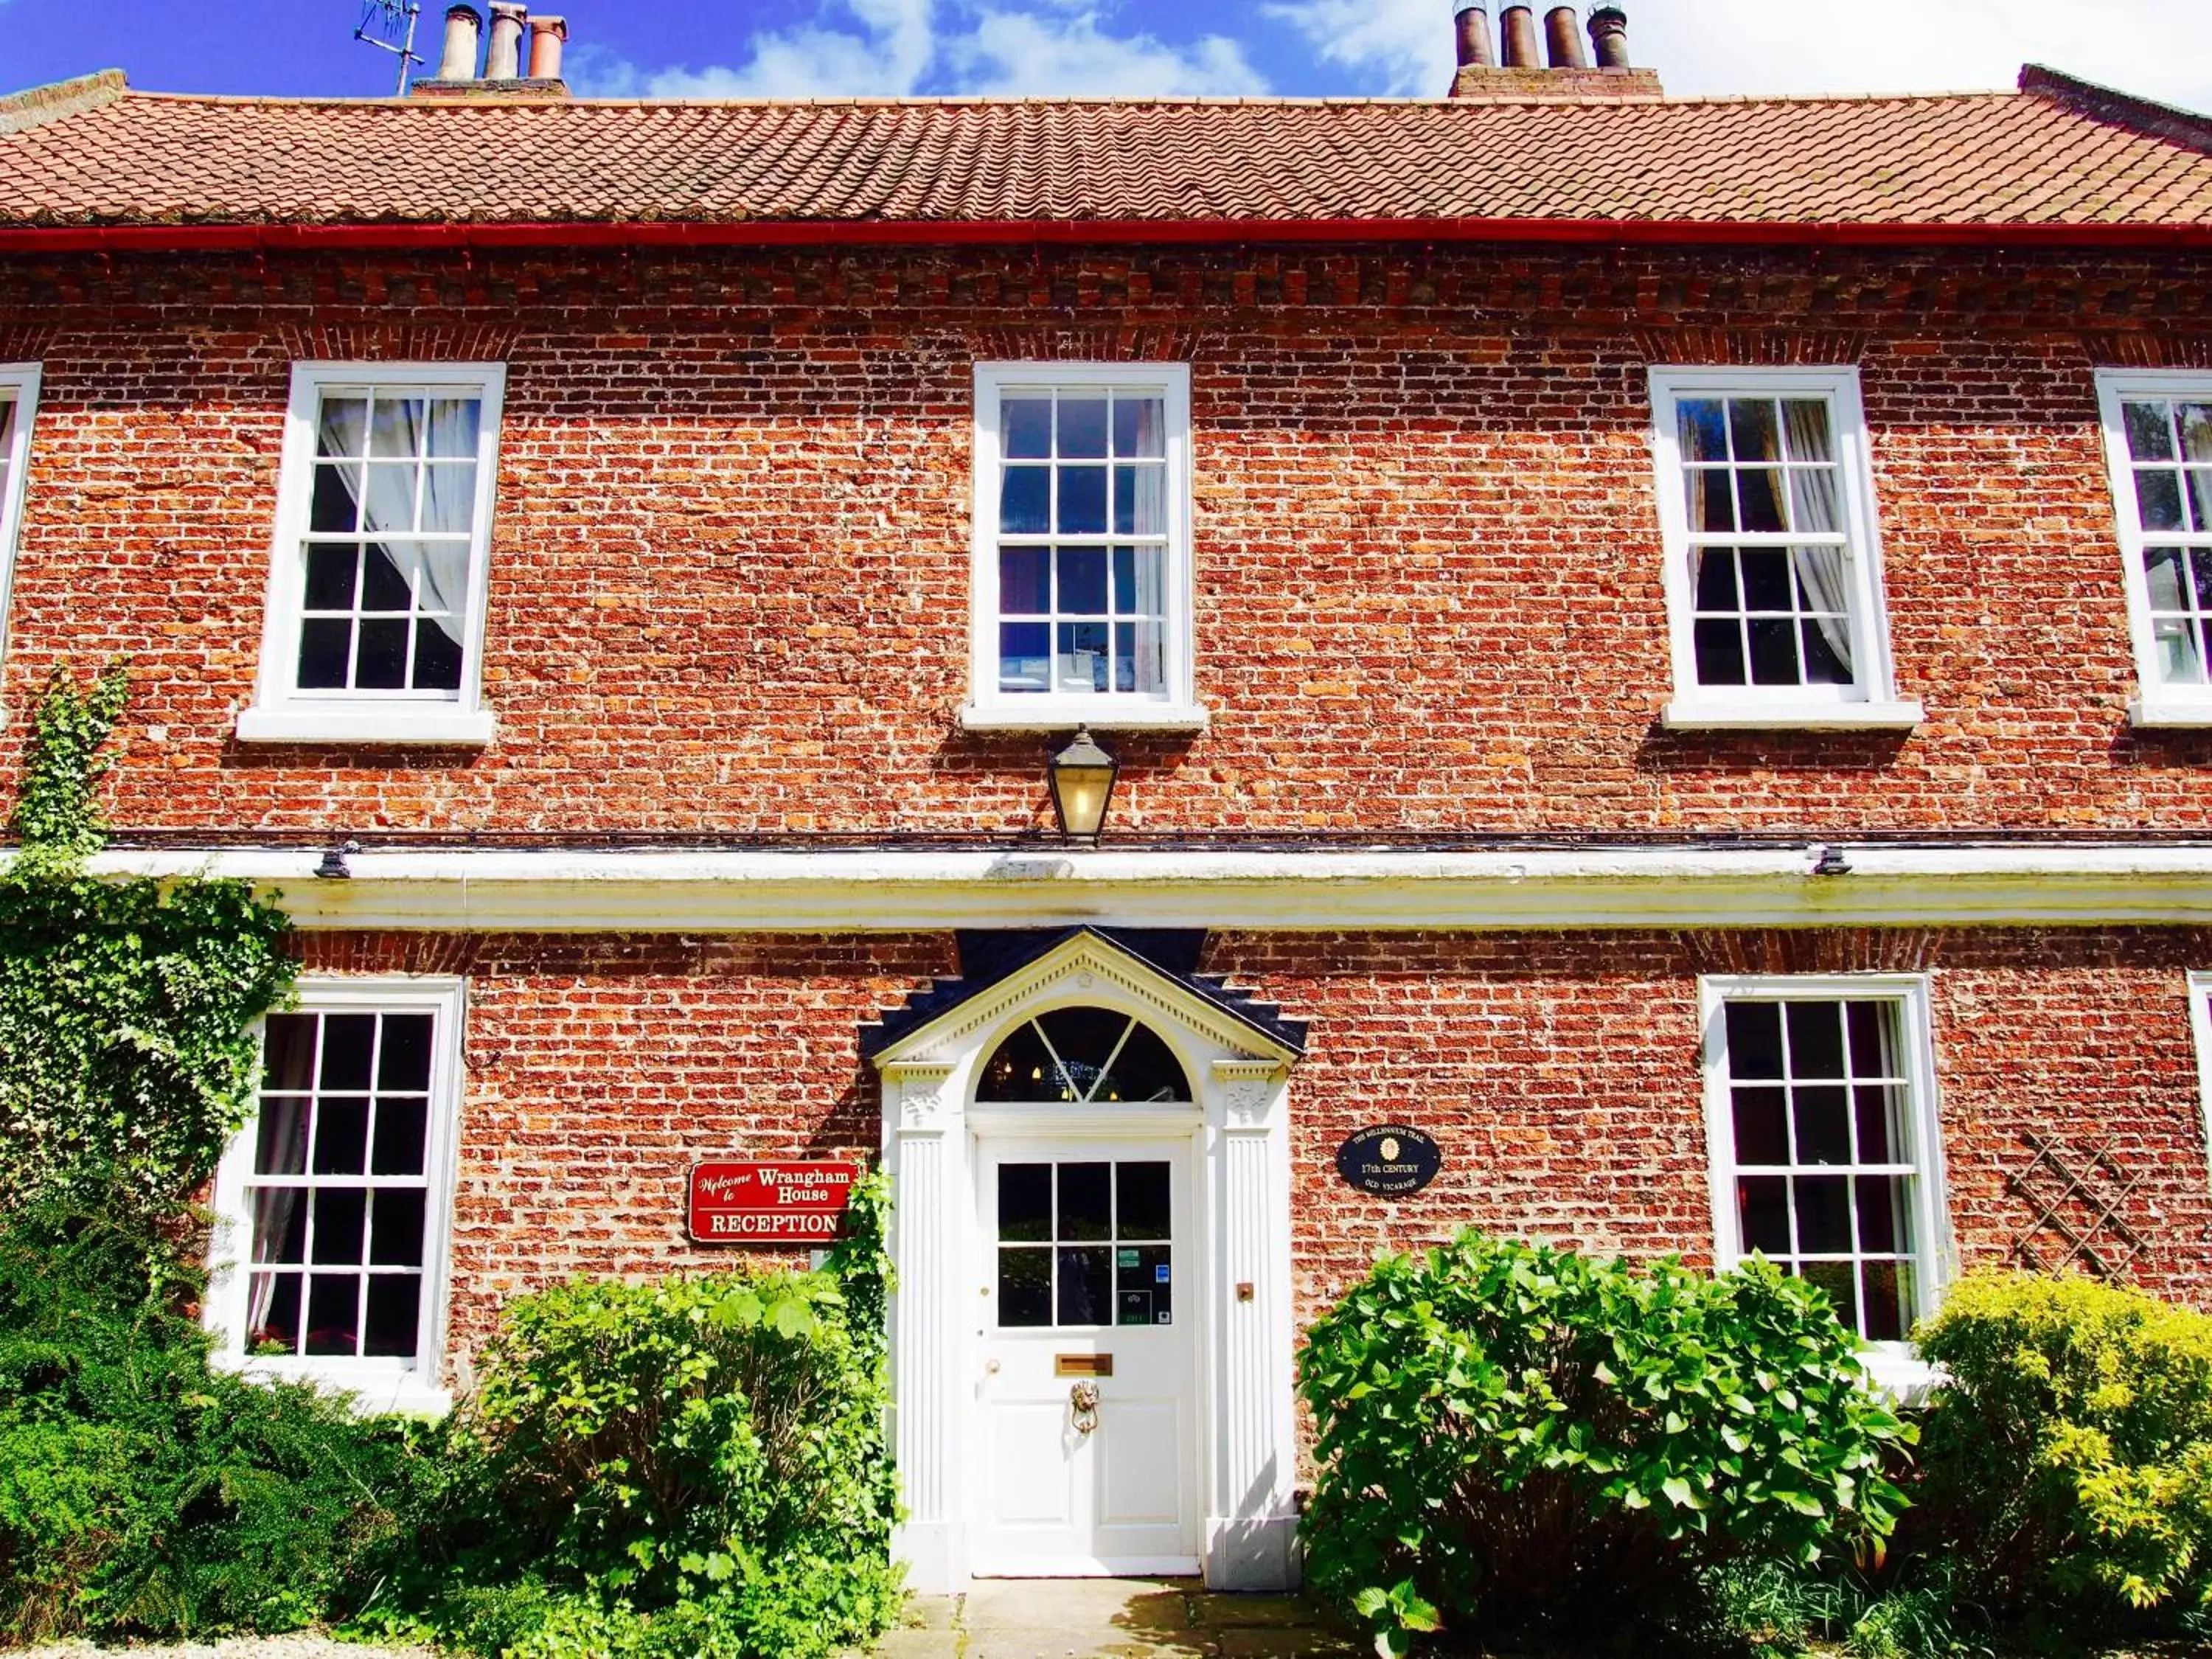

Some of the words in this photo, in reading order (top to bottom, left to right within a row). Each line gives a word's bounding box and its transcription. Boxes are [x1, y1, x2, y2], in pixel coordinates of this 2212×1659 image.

[757, 1169, 849, 1186] Wrangham
[1362, 1164, 1381, 1174] 17th
[1382, 1164, 1419, 1174] CENTURY
[698, 1173, 751, 1196] Welcome
[1365, 1179, 1380, 1189] OLD
[1382, 1178, 1416, 1191] VICARAGE
[723, 1188, 734, 1202] to
[777, 1186, 828, 1204] House
[710, 1215, 839, 1232] RECEPTION
